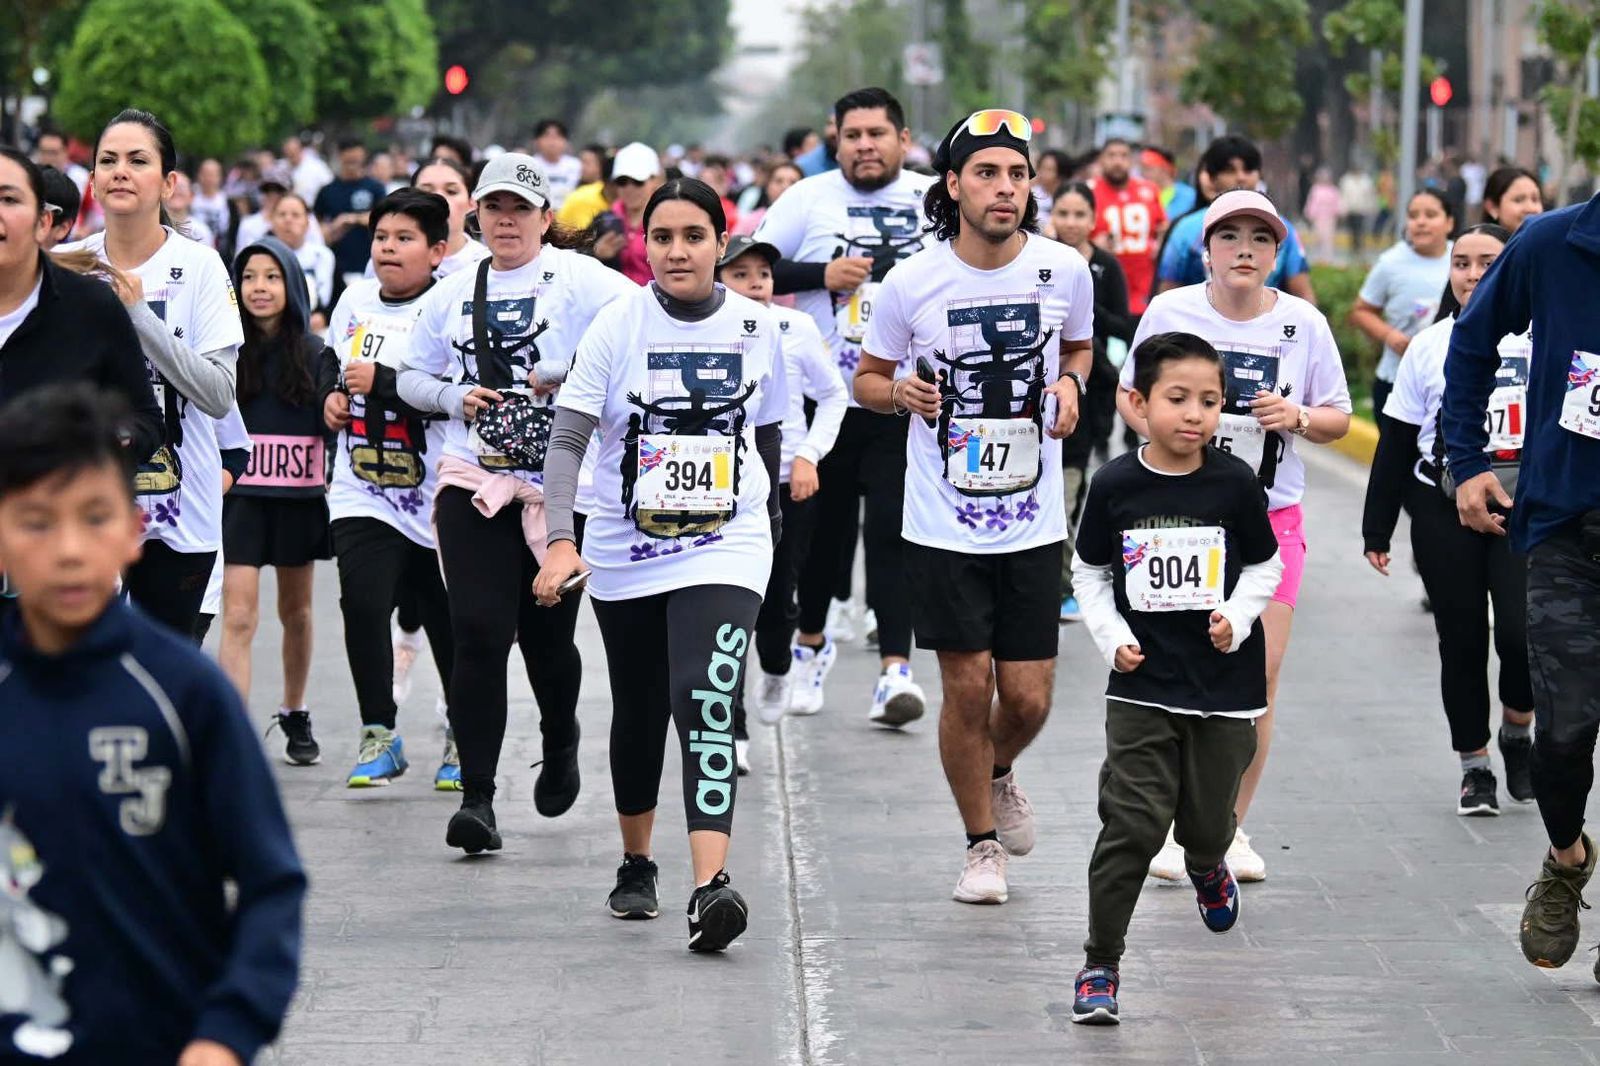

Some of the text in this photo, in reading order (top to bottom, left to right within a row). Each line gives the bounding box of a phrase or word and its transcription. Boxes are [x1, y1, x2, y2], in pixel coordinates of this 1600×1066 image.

[1103, 202, 1150, 253] 19
[861, 301, 872, 322] 9
[362, 333, 385, 358] 97
[980, 443, 1010, 471] 47
[665, 461, 713, 491] 394
[1148, 555, 1201, 590] 904
[690, 623, 747, 816] adidas
